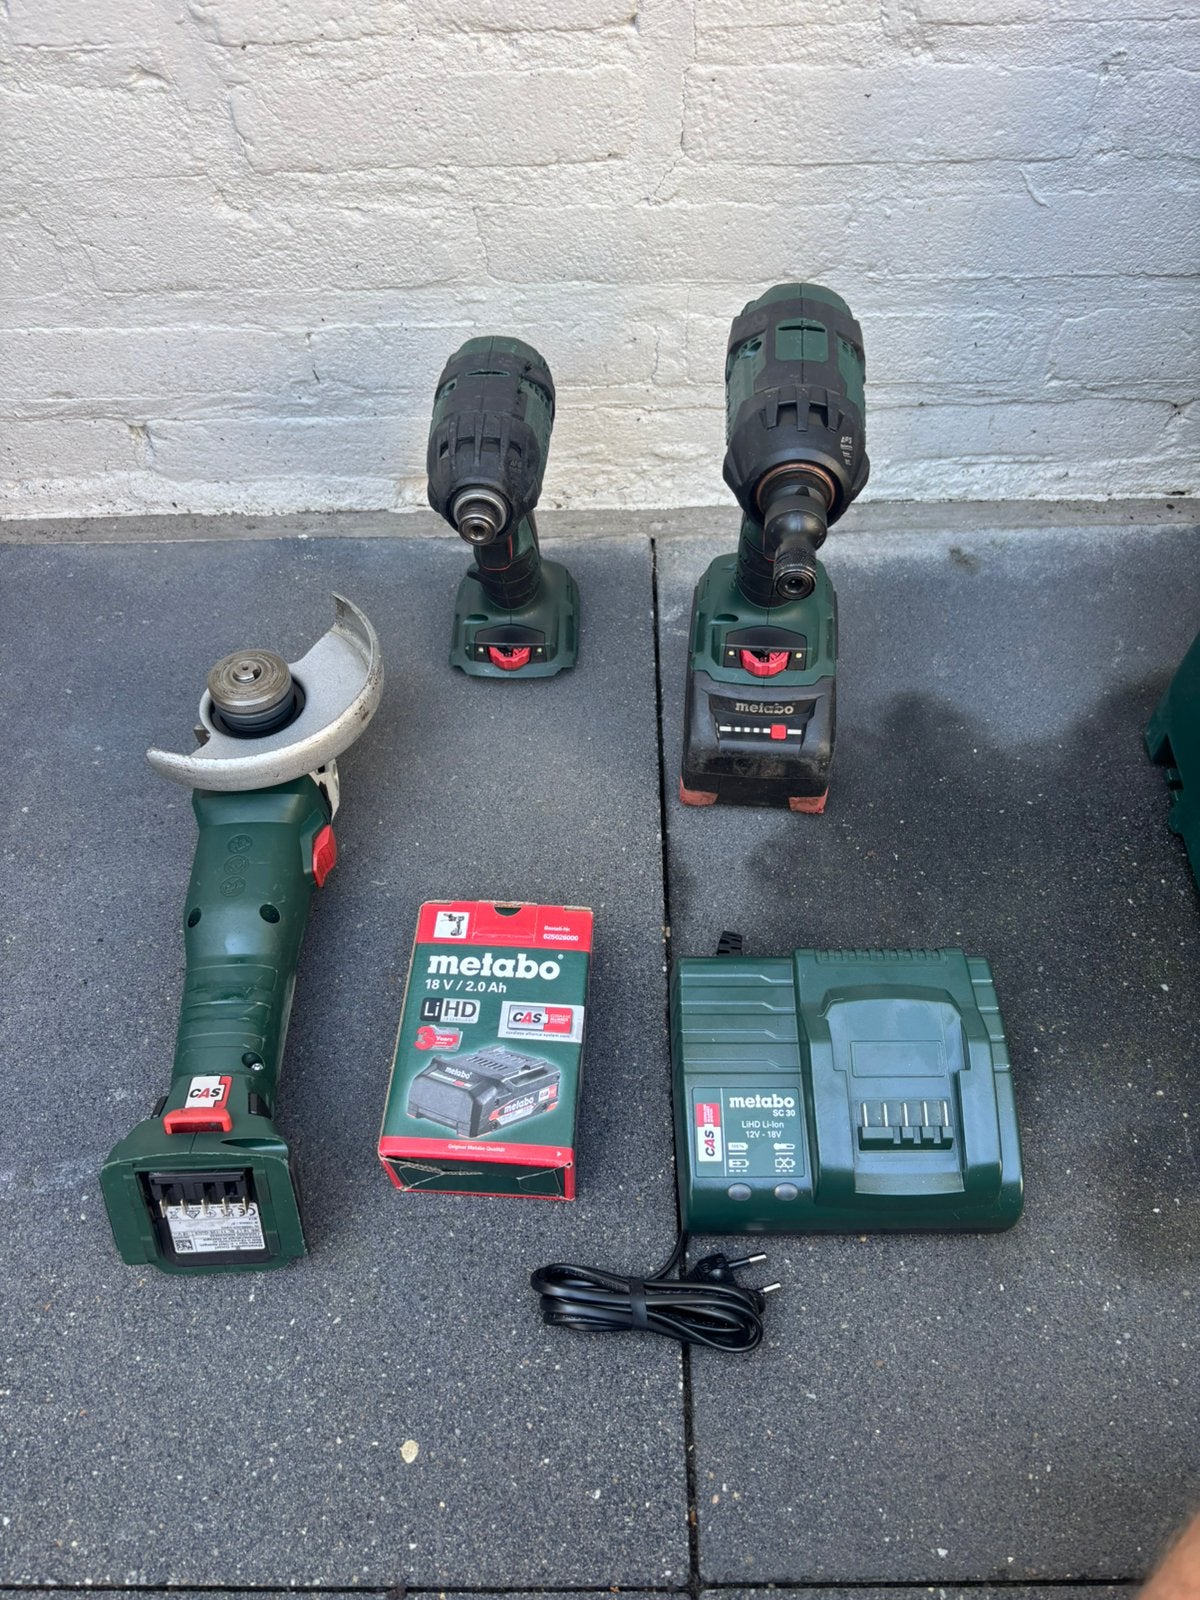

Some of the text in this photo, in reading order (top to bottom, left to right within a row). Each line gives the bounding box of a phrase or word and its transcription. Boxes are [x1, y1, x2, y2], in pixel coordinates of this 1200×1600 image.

[735, 702, 794, 714] metabo
[427, 953, 560, 980] metabo
[425, 979, 507, 993] 18 V / 2.0 Ah
[513, 1011, 542, 1023] CAS
[414, 1026, 436, 1050] 3
[445, 1066, 470, 1079] metabo
[190, 1088, 221, 1098] CAS
[504, 1097, 534, 1113] metabo
[729, 1093, 795, 1108] metabo
[772, 1109, 796, 1117] SC 30
[741, 1120, 785, 1128] LiHD Li-Ion
[745, 1130, 760, 1138] 12V
[767, 1130, 781, 1138] 18V
[704, 1130, 716, 1157] CAS
